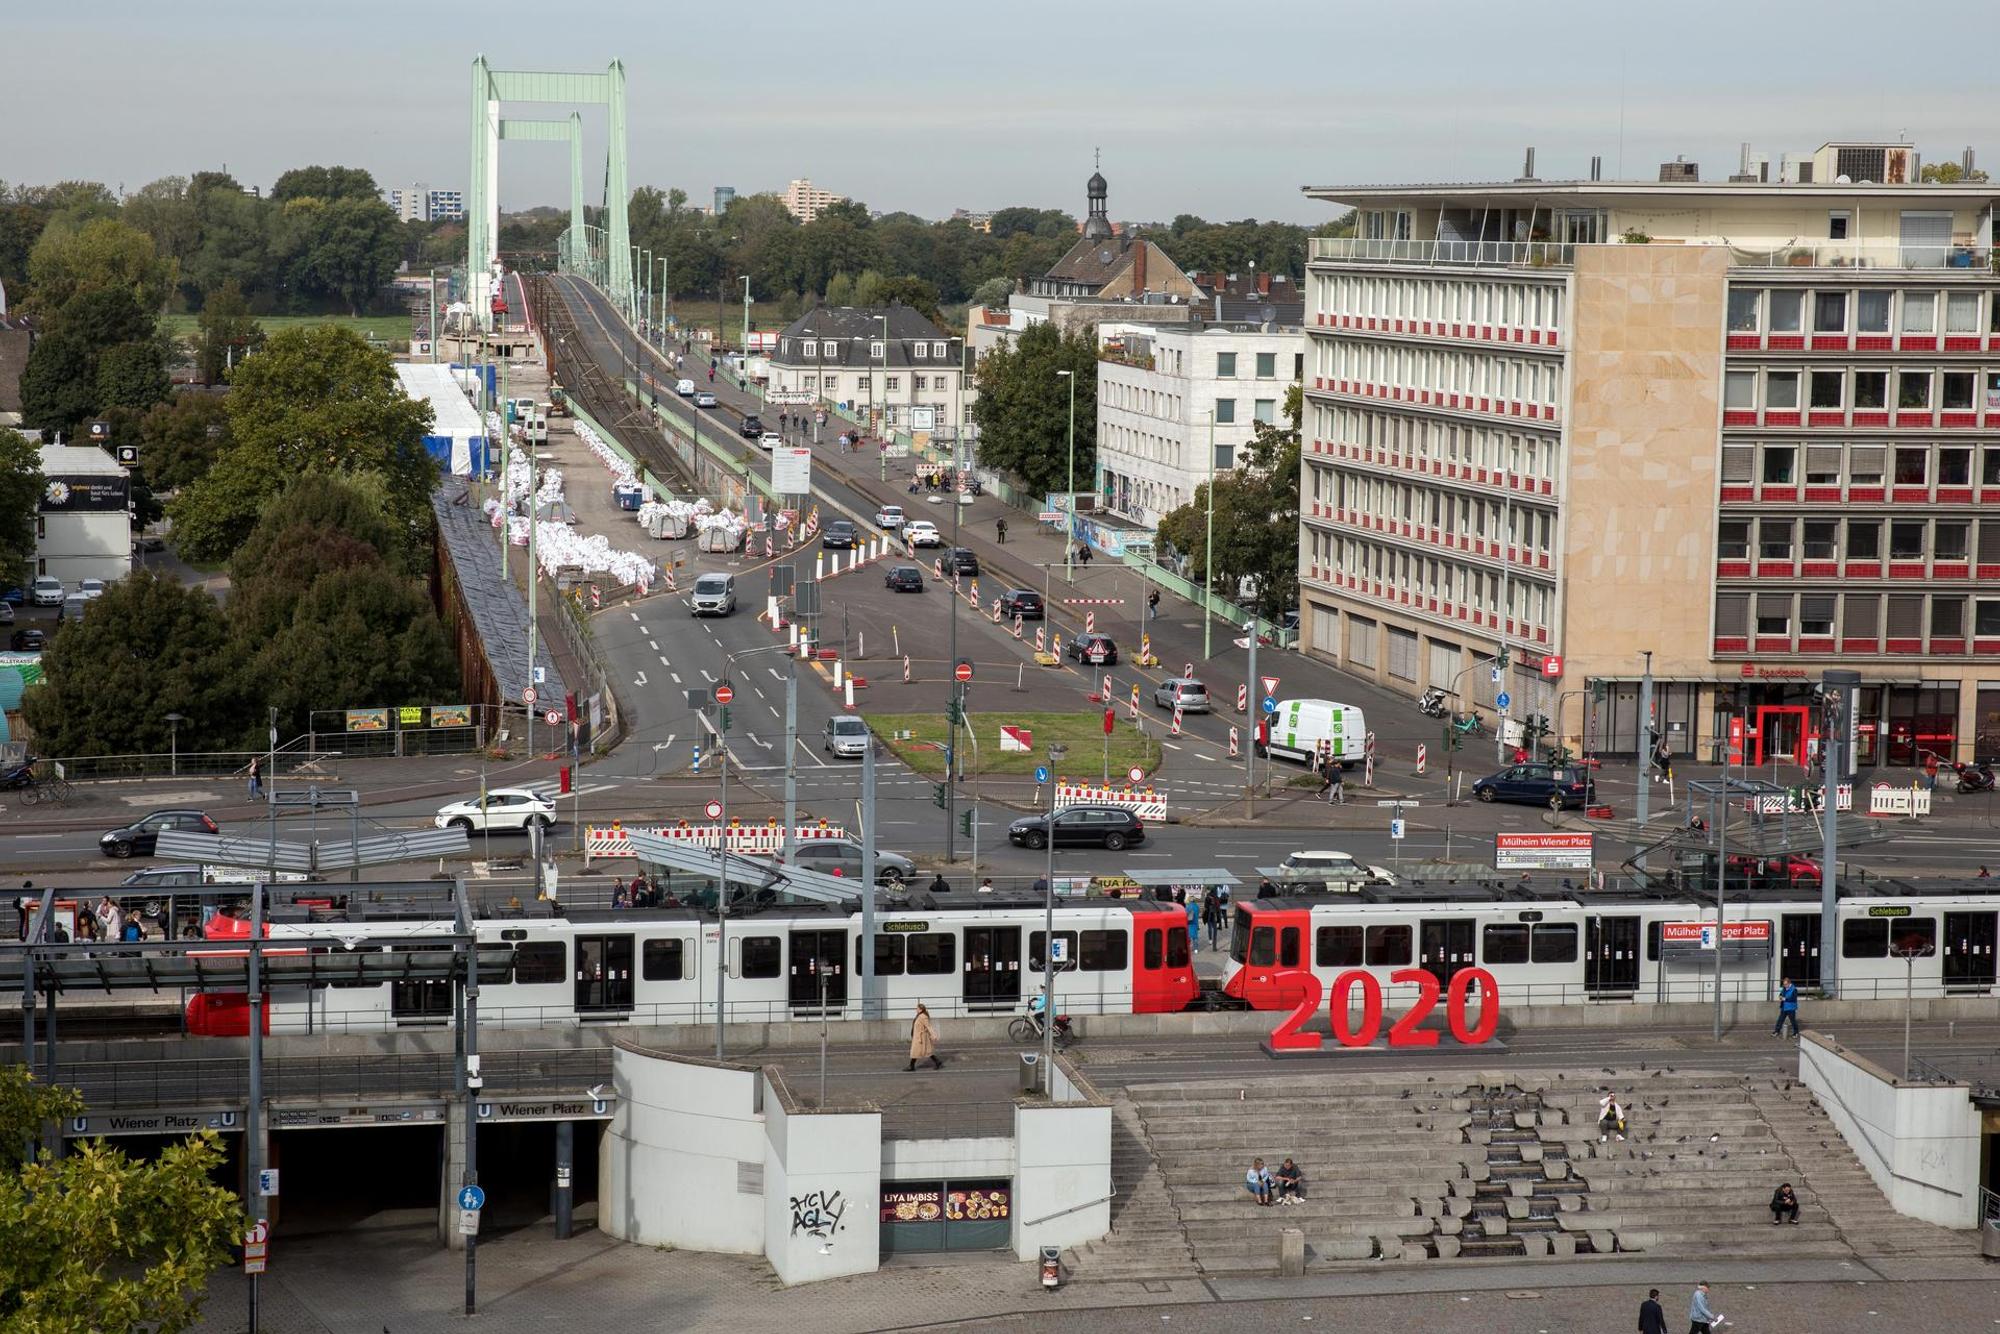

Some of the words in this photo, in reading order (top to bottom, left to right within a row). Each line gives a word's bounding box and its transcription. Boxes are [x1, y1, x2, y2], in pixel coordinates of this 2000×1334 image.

[1502, 836, 1539, 846] Mülheim
[1541, 836, 1570, 846] Wiener
[1571, 836, 1591, 846] Platz
[887, 921, 926, 931] Schlebusch
[1744, 926, 1766, 936] Platz
[1271, 967, 1499, 1048] 2020
[500, 1104, 548, 1116] Wiener
[552, 1103, 584, 1114] Platz
[110, 1117, 160, 1130] Wiener
[164, 1115, 198, 1128] Platz
